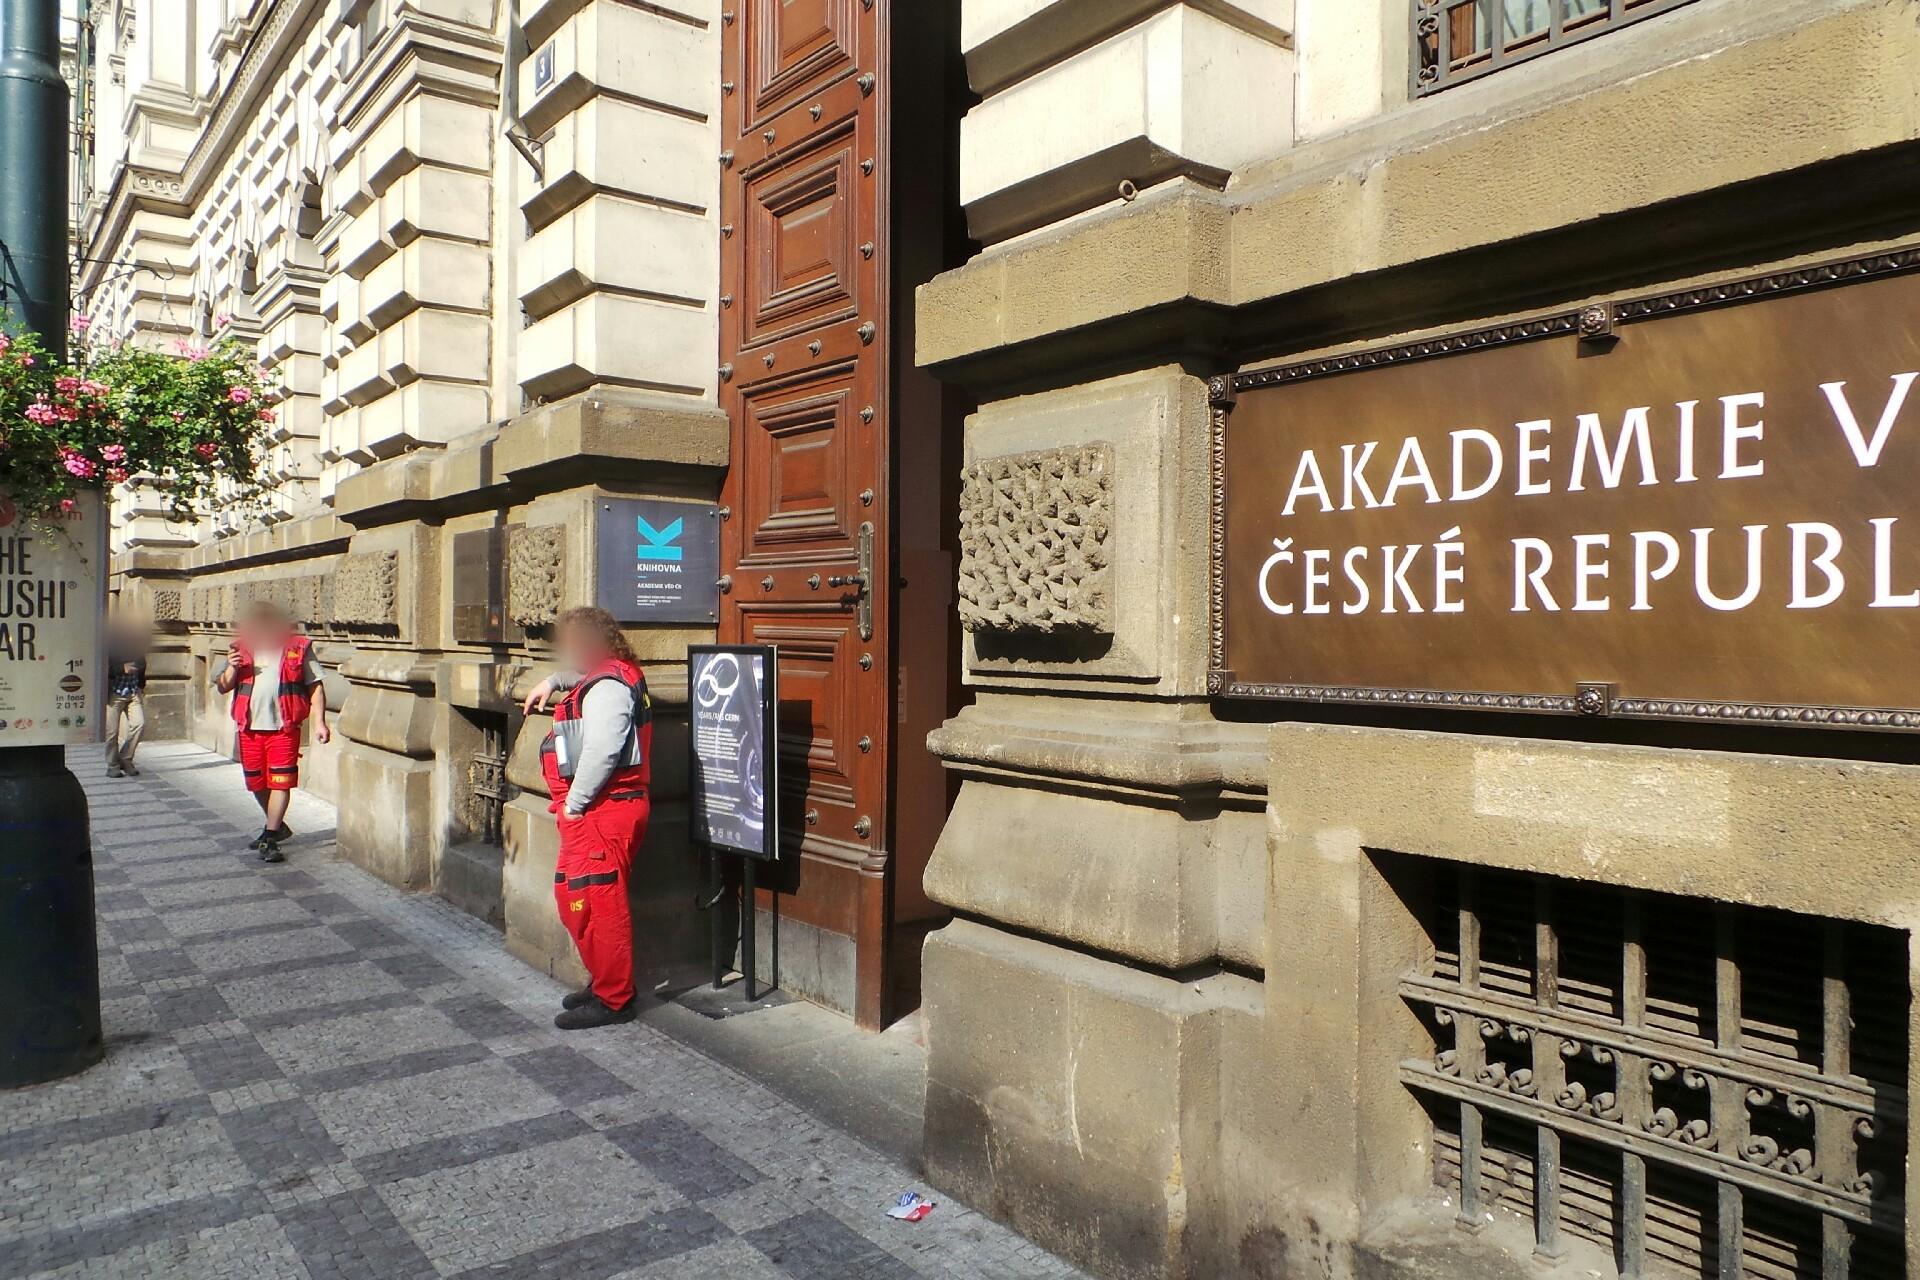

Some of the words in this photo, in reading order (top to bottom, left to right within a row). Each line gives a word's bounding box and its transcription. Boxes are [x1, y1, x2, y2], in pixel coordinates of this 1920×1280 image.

[1282, 392, 1763, 515] AKADEMIE
[637, 563, 682, 573] KNIHOVNA
[1259, 525, 1464, 614] ČESKÉ
[1511, 518, 1920, 611] REPUBL
[67, 693, 86, 702] food
[56, 701, 85, 710] 2012
